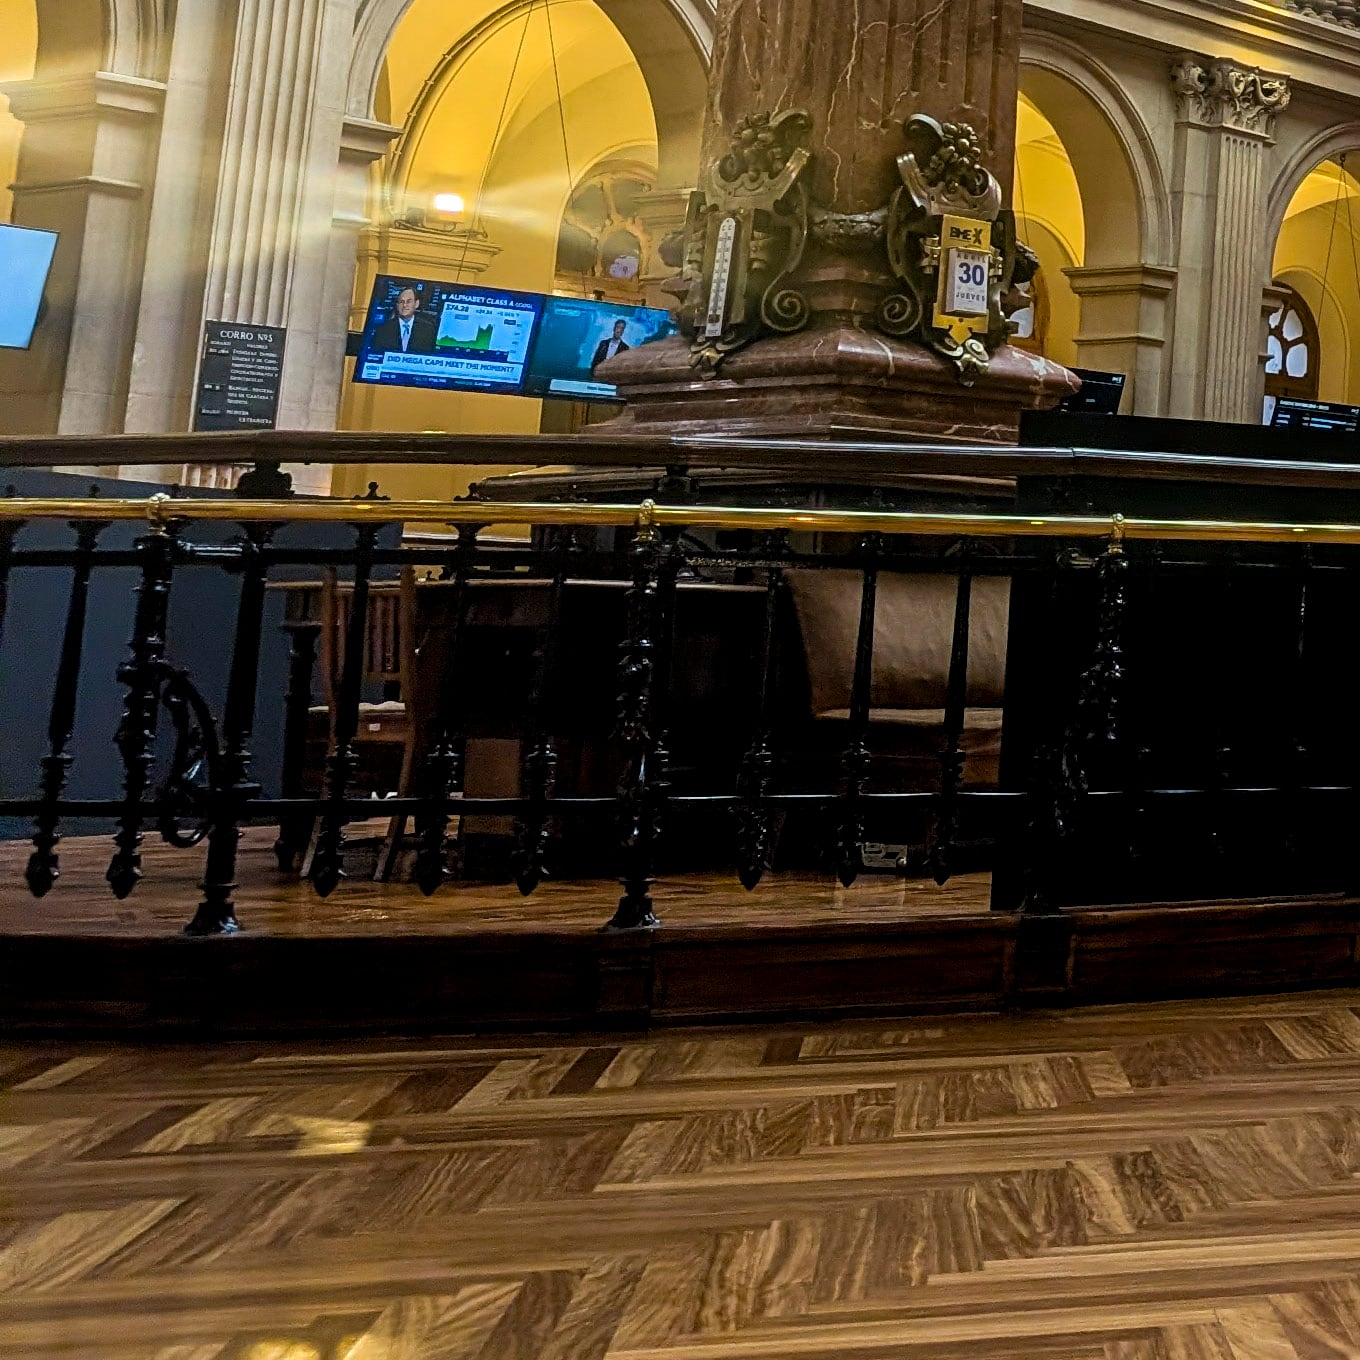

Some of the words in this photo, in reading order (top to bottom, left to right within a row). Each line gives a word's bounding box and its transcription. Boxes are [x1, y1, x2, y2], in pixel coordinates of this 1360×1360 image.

[959, 262, 984, 286] 30
[487, 298, 507, 306] CLASS
[220, 331, 253, 340] CORRO
